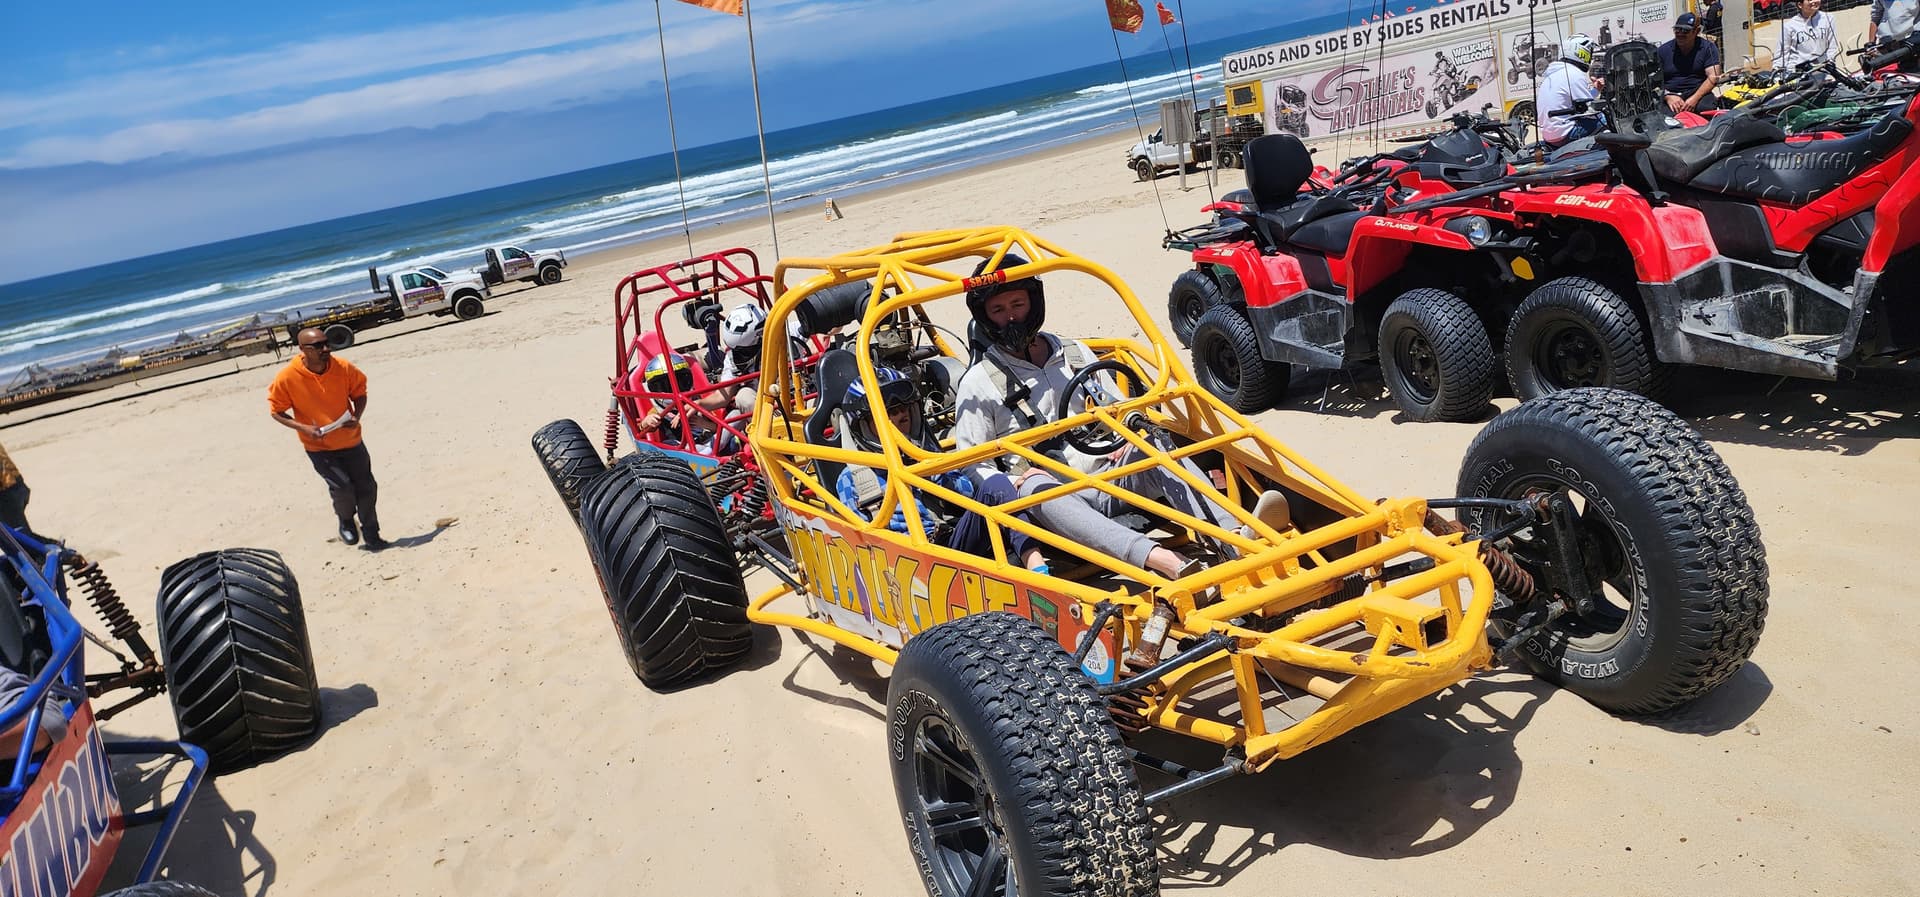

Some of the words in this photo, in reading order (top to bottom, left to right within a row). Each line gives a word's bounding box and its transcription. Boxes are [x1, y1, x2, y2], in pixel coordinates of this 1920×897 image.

[1228, 51, 1275, 74] QUADS
[1279, 44, 1310, 63] AND
[1314, 34, 1348, 56] SIDE
[1353, 28, 1372, 47] BY
[1377, 17, 1424, 42] SIDES
[1430, 0, 1510, 30] RENTALS
[1453, 49, 1496, 66] WELCOME
[1330, 104, 1361, 133] ATV
[1360, 87, 1425, 126] RENTALS
[968, 272, 1000, 289] SB204
[1087, 658, 1102, 672] 204
